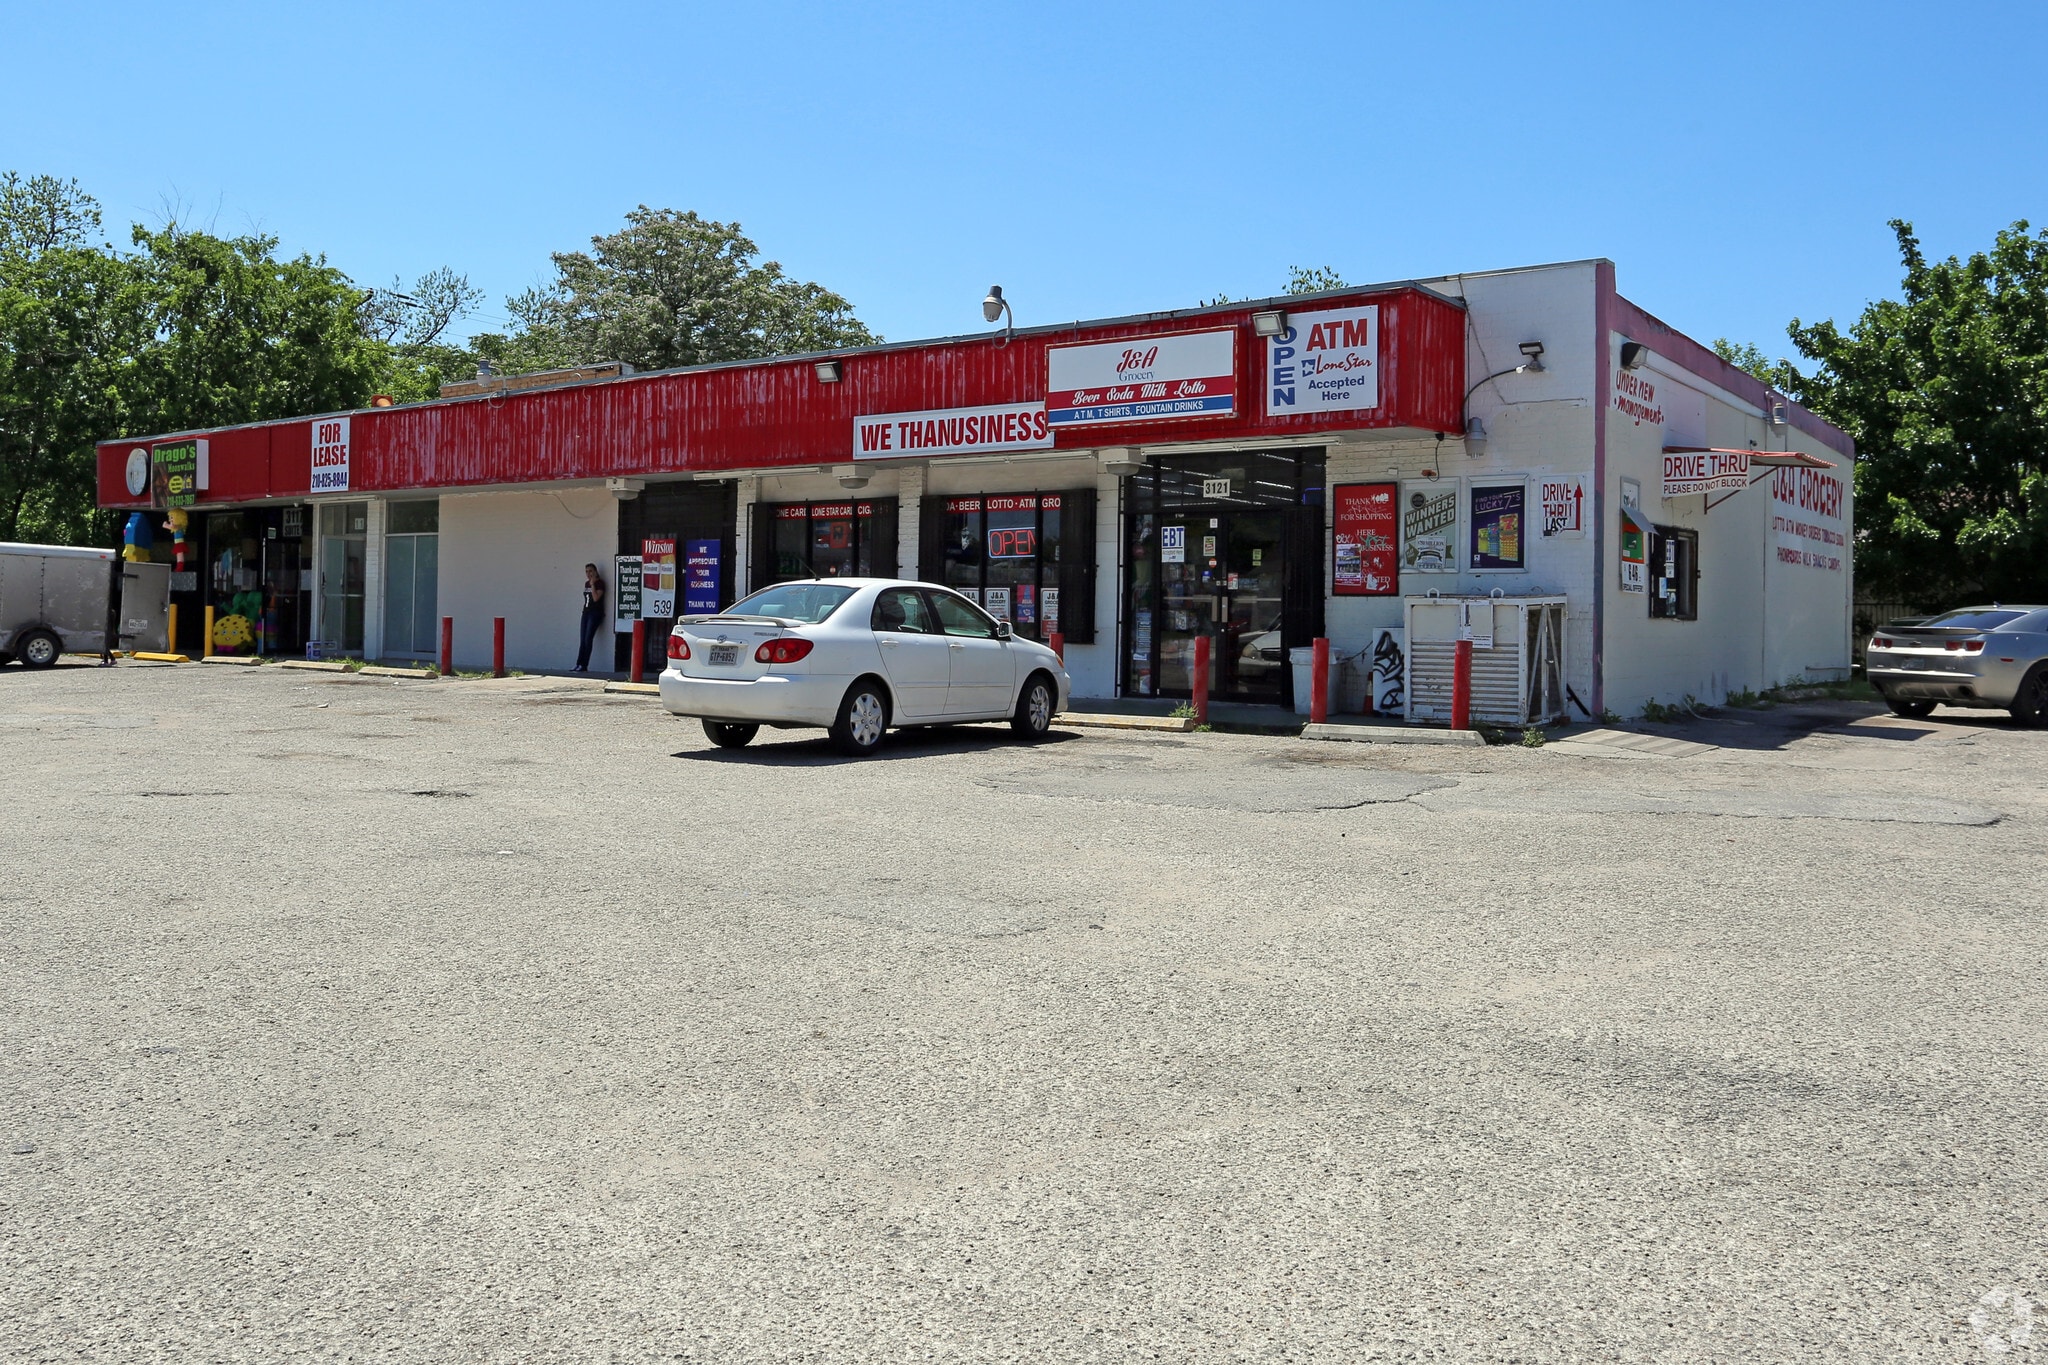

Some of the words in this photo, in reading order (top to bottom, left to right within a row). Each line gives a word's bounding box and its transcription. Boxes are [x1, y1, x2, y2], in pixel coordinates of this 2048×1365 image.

[1306, 318, 1367, 351] ATM
[1116, 346, 1159, 373] J&A
[1272, 325, 1297, 407] OPEN
[1316, 354, 1345, 374] Lone
[1344, 352, 1373, 372] Star
[1118, 371, 1155, 382] Grocery
[1308, 375, 1365, 390] Accepted
[1072, 391, 1101, 405] Beer
[1107, 386, 1135, 400] Soda
[1140, 382, 1167, 398] Milk
[1173, 380, 1206, 397] Lotto
[1322, 391, 1350, 401] Here
[1135, 403, 1174, 415] FOUNTAIN
[1175, 400, 1204, 412] DRINKS
[319, 423, 341, 445] FOR
[861, 423, 892, 452] WE
[154, 445, 196, 463] Drago's
[313, 445, 346, 468] LEASE
[1664, 455, 1705, 478] DRIVE
[1709, 455, 1748, 476] THRU
[1205, 482, 1228, 495] 3121
[1543, 483, 1572, 502] DRIVE
[1664, 484, 1691, 494] PLEASE
[1693, 483, 1704, 492] DO
[1705, 480, 1719, 491] NOT
[1721, 478, 1747, 488] BLOCK
[1773, 466, 1795, 505] J&A
[1800, 467, 1843, 520] GROCERY
[811, 507, 826, 516] LONE
[825, 506, 840, 516] STAR
[959, 501, 981, 511] BEER
[987, 499, 1014, 509] LOTTO
[1019, 498, 1036, 508] ATM
[1406, 496, 1455, 525] WINNERS
[1475, 500, 1503, 511] LUCKY
[1355, 512, 1392, 520] SHOPPING
[1407, 508, 1455, 539] WANTED
[645, 540, 673, 554] Winston
[1162, 528, 1184, 547] EBT
